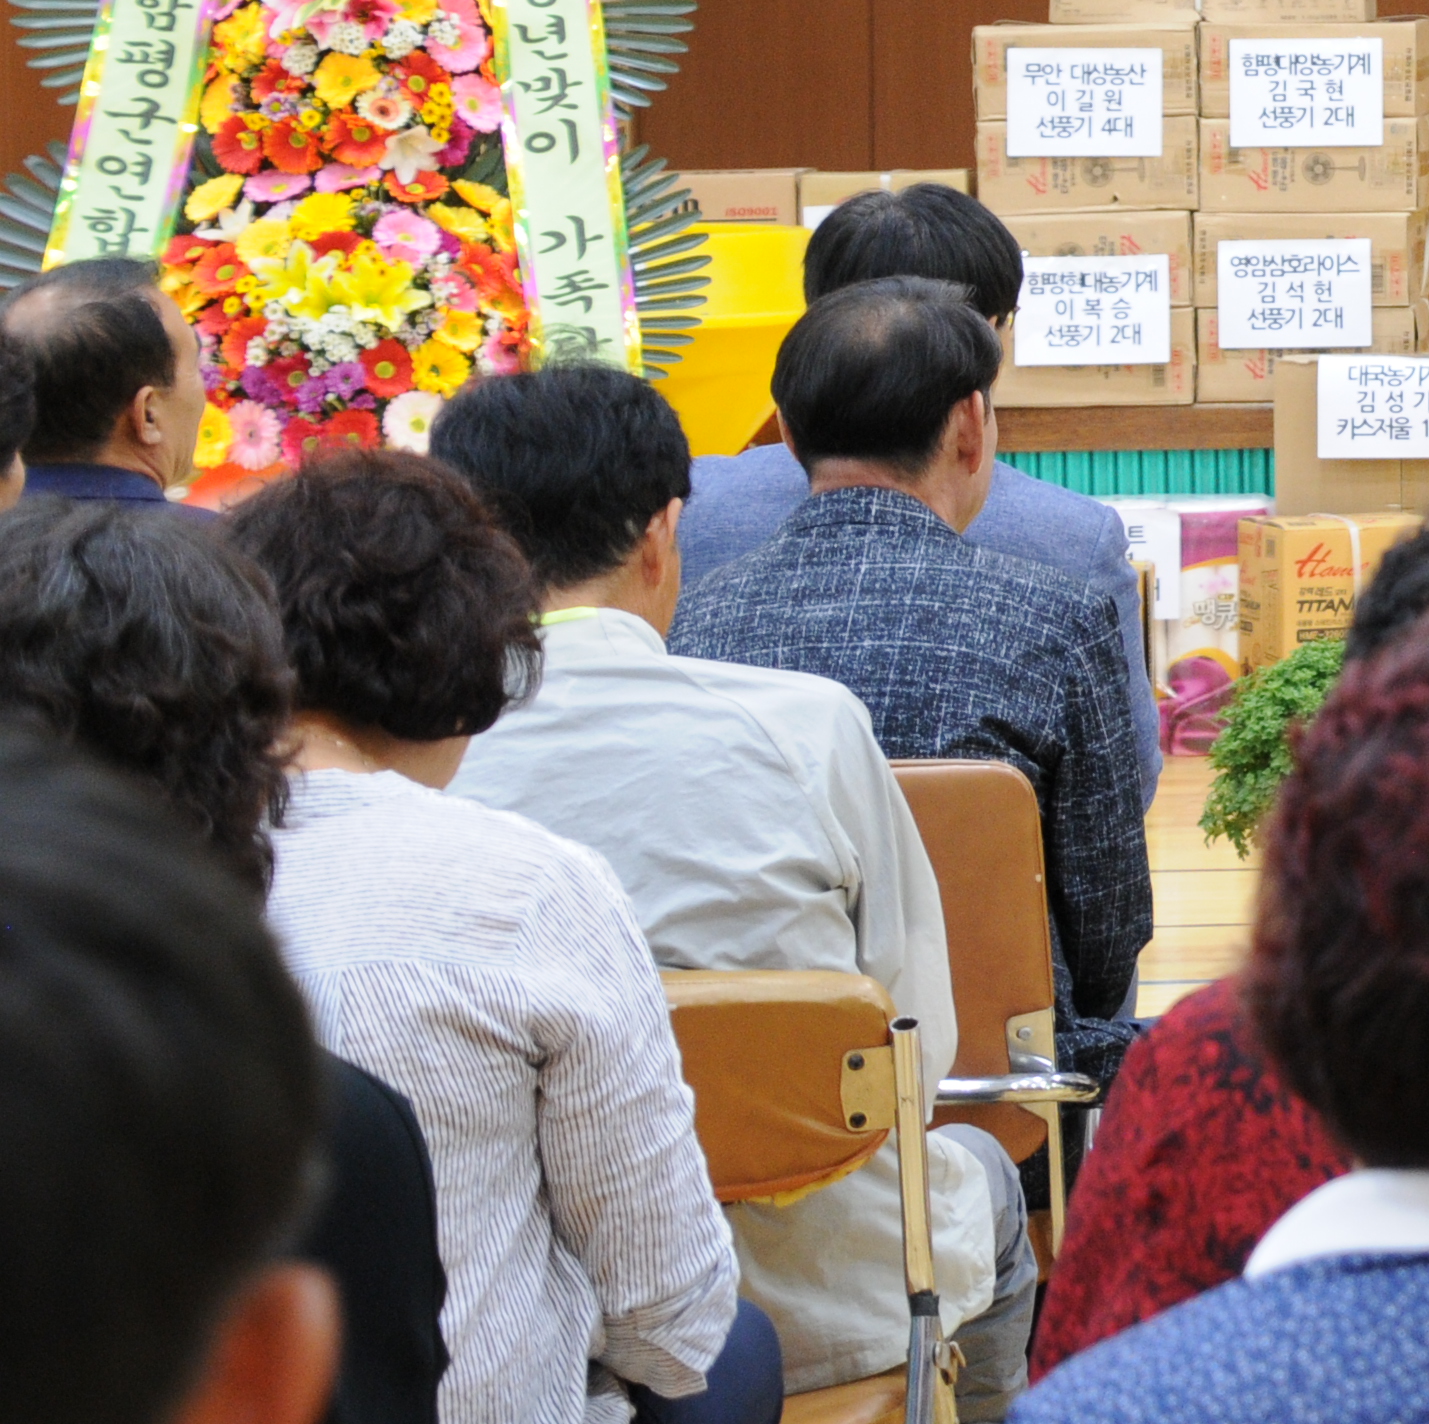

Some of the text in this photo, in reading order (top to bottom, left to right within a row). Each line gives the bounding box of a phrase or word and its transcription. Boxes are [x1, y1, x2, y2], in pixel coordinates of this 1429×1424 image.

[1022, 62, 1148, 86] 무안 대상농산
[1036, 115, 1134, 138] 선풍기 4대
[1258, 105, 1356, 129] 선풍기 2대
[1247, 307, 1344, 330] 선풍기 2대
[1044, 323, 1142, 347] 선풍기 2대
